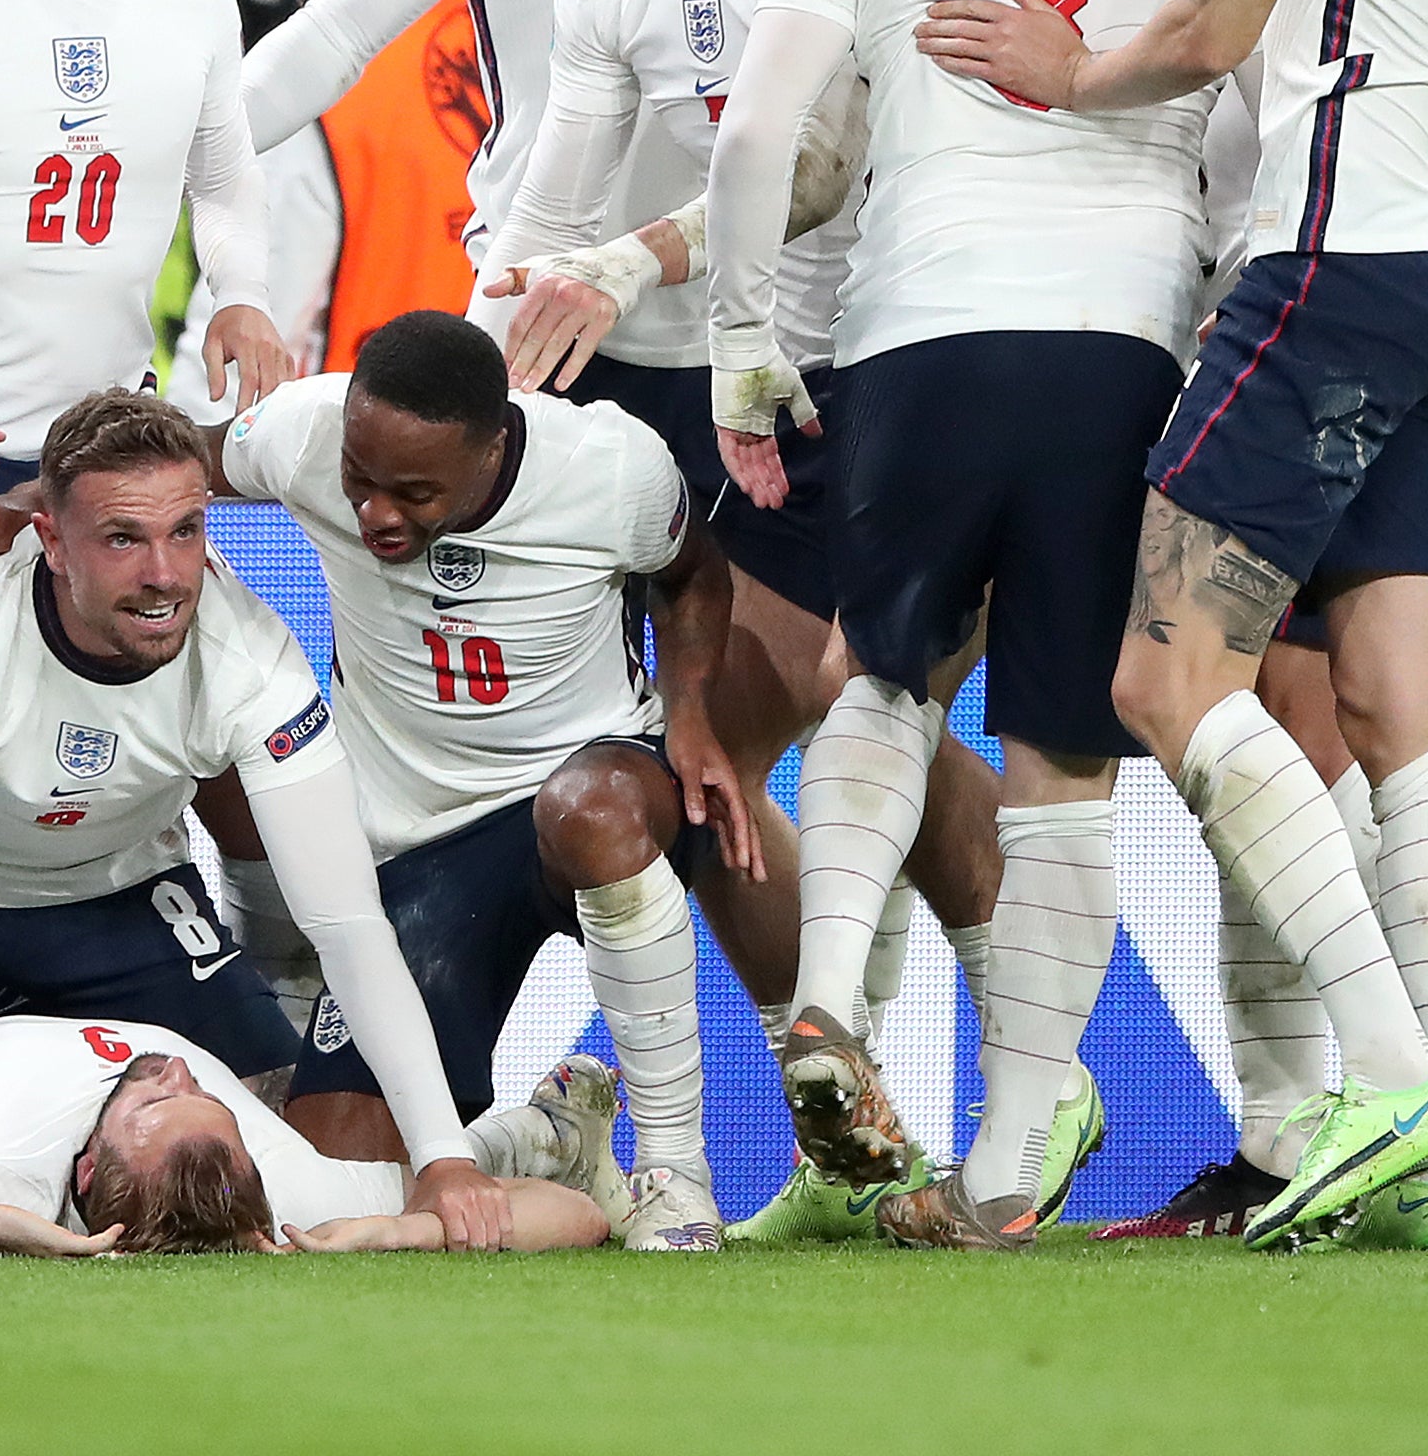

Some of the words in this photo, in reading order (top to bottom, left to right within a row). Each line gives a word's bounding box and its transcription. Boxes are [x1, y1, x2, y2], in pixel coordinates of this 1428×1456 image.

[26, 152, 122, 246] 20
[422, 628, 510, 705] 10
[151, 880, 221, 957] 8
